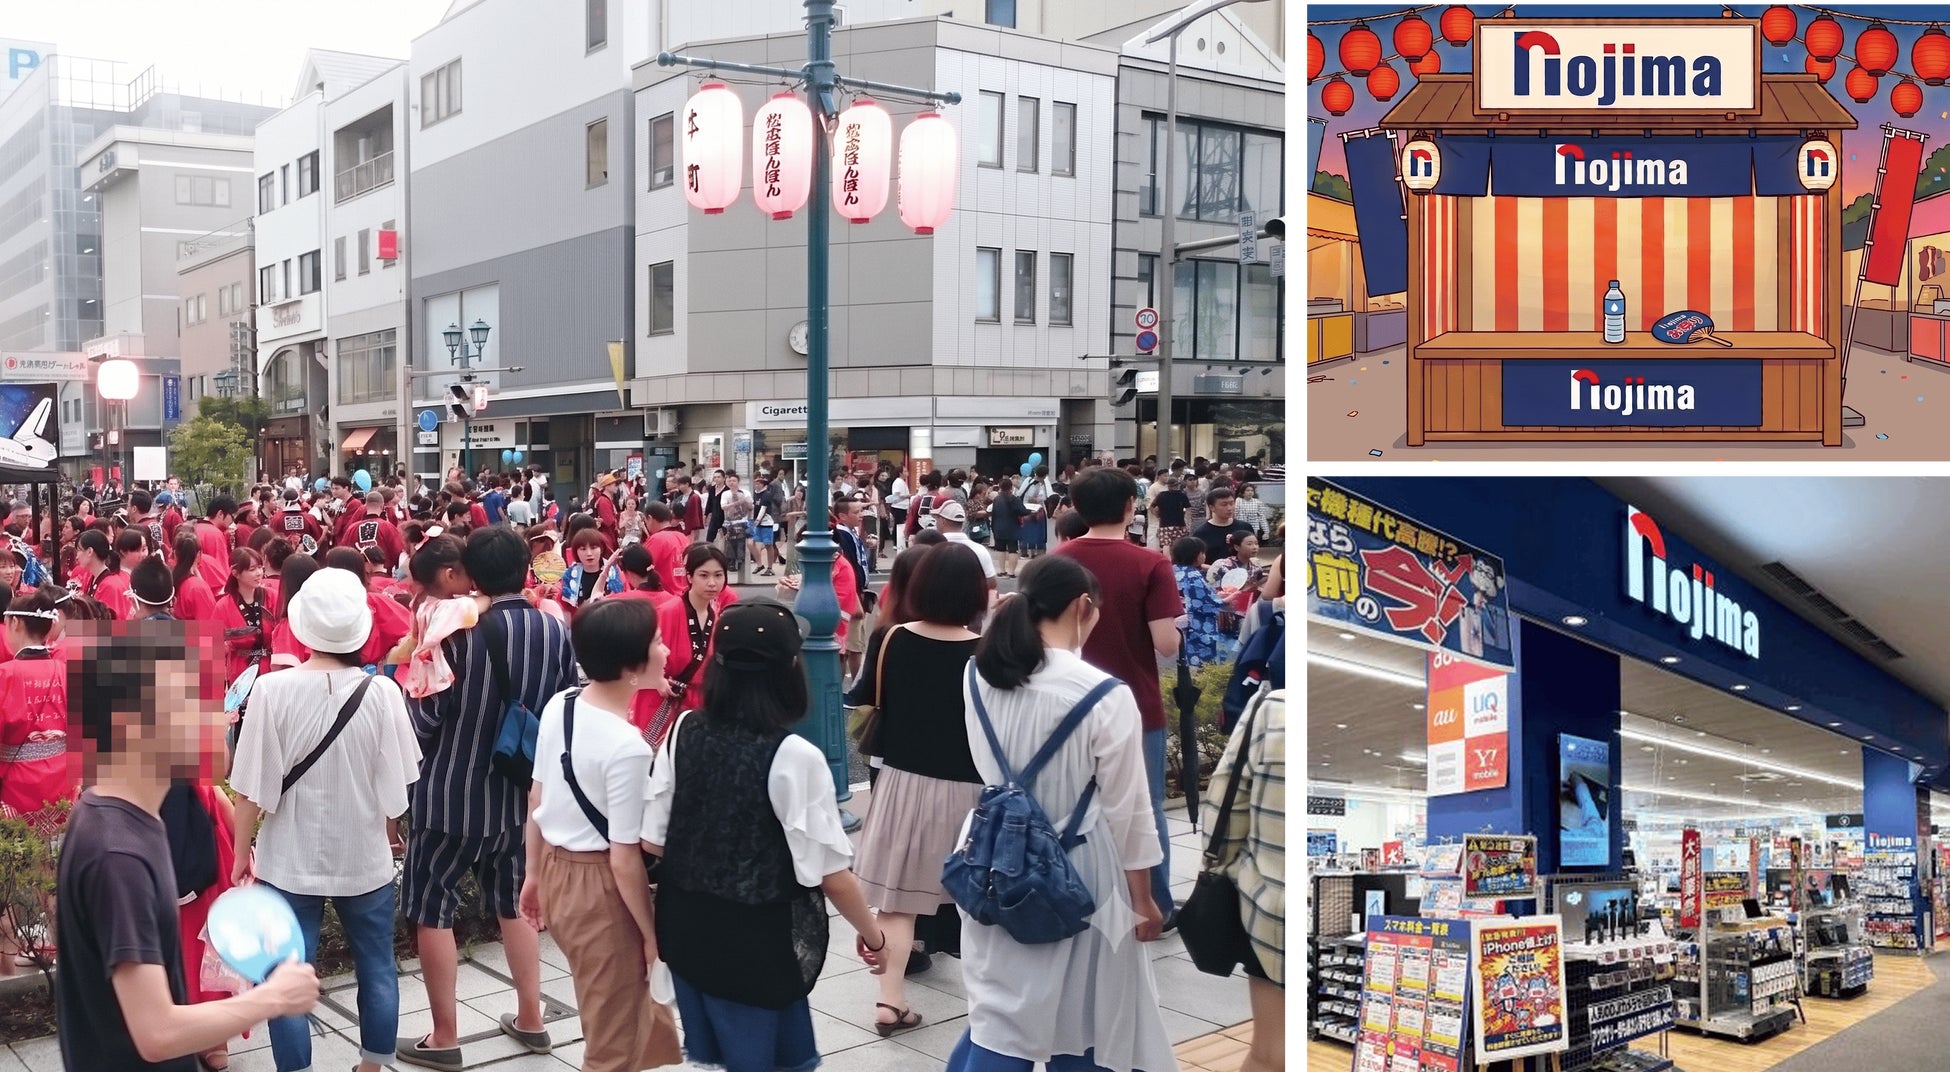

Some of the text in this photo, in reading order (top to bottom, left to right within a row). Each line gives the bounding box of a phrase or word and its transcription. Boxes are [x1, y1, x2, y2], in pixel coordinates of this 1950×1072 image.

[9, 48, 39, 78] P
[1473, 692, 1498, 713] UQ
[1434, 709, 1458, 727] au
[1474, 748, 1498, 768] Y!
